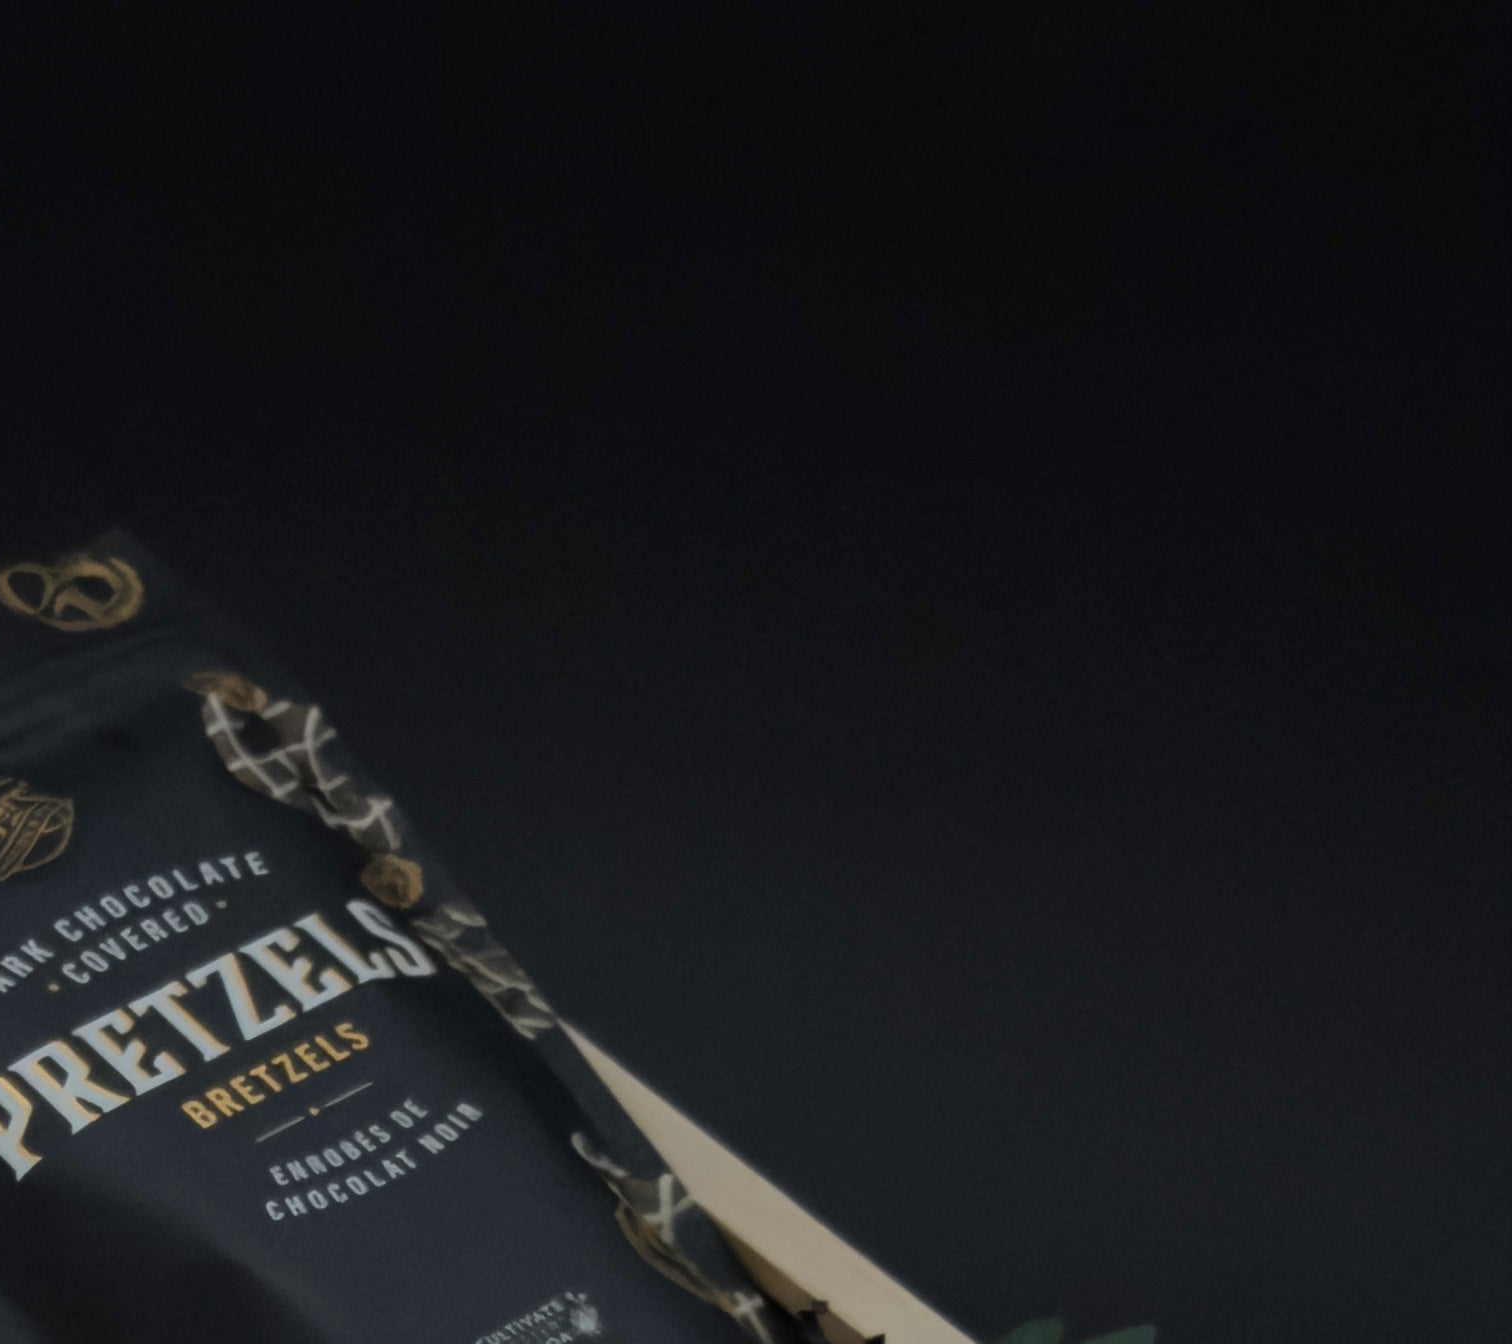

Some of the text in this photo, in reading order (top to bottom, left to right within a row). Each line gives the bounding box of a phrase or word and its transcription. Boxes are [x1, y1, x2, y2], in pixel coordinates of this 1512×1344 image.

[53, 851, 271, 942] CHOCOLATE
[60, 900, 210, 984] COVERED
[180, 1021, 371, 1130] BRETZELS
[389, 1097, 430, 1129] DE
[265, 1102, 484, 1222] CHOCOLAT NOIR
